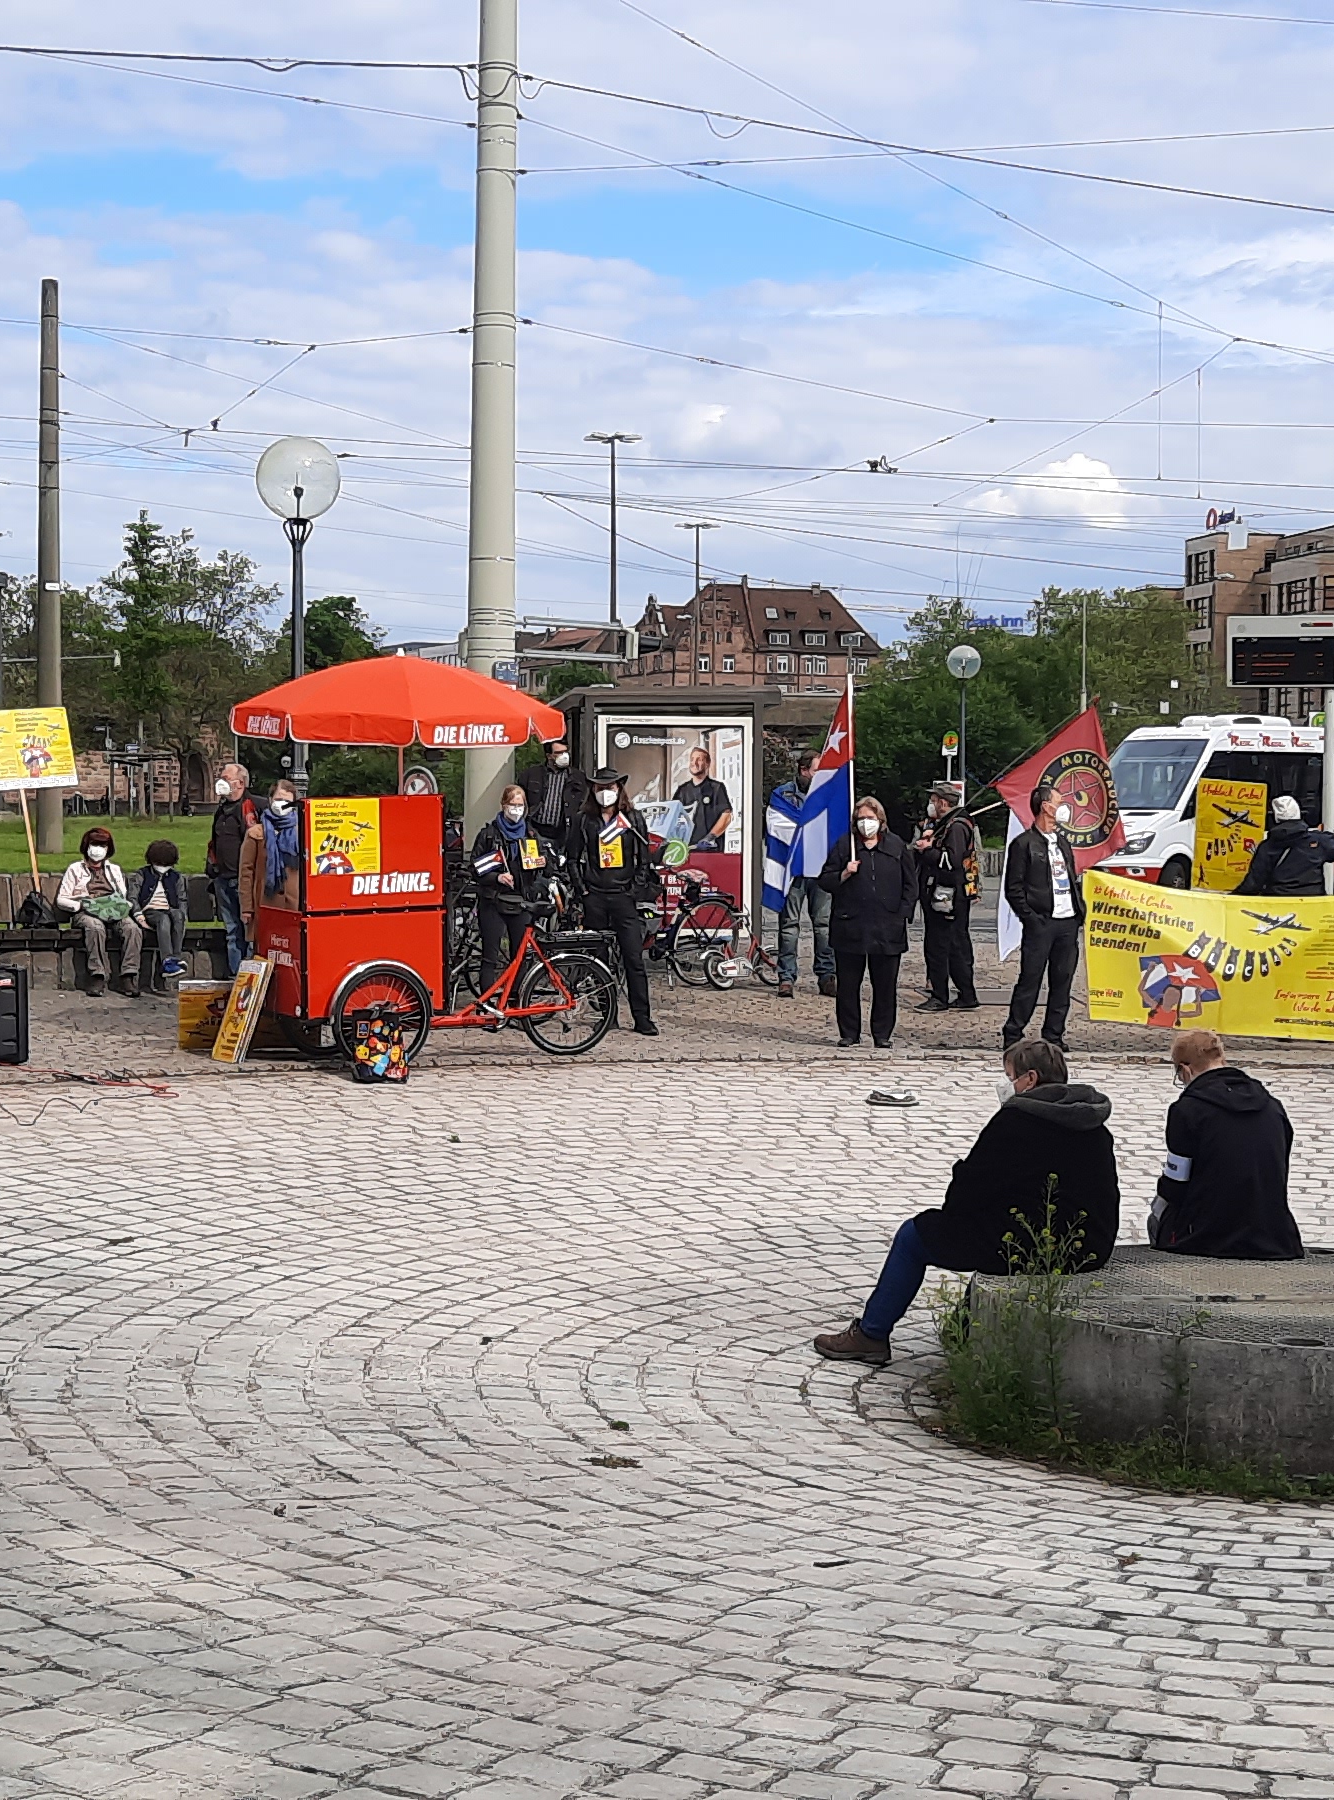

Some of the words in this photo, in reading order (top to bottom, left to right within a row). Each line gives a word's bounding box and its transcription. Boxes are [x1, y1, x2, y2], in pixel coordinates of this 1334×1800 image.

[434, 726, 457, 744] DIE
[458, 724, 509, 743] LINKE.
[352, 875, 380, 895] DIE
[382, 871, 435, 894] LINKE.
[1092, 901, 1195, 932] Wirtschaftskrieg
[1090, 919, 1127, 934] gegen
[1129, 923, 1162, 939] Kuba
[1090, 934, 1147, 954] beenden!
